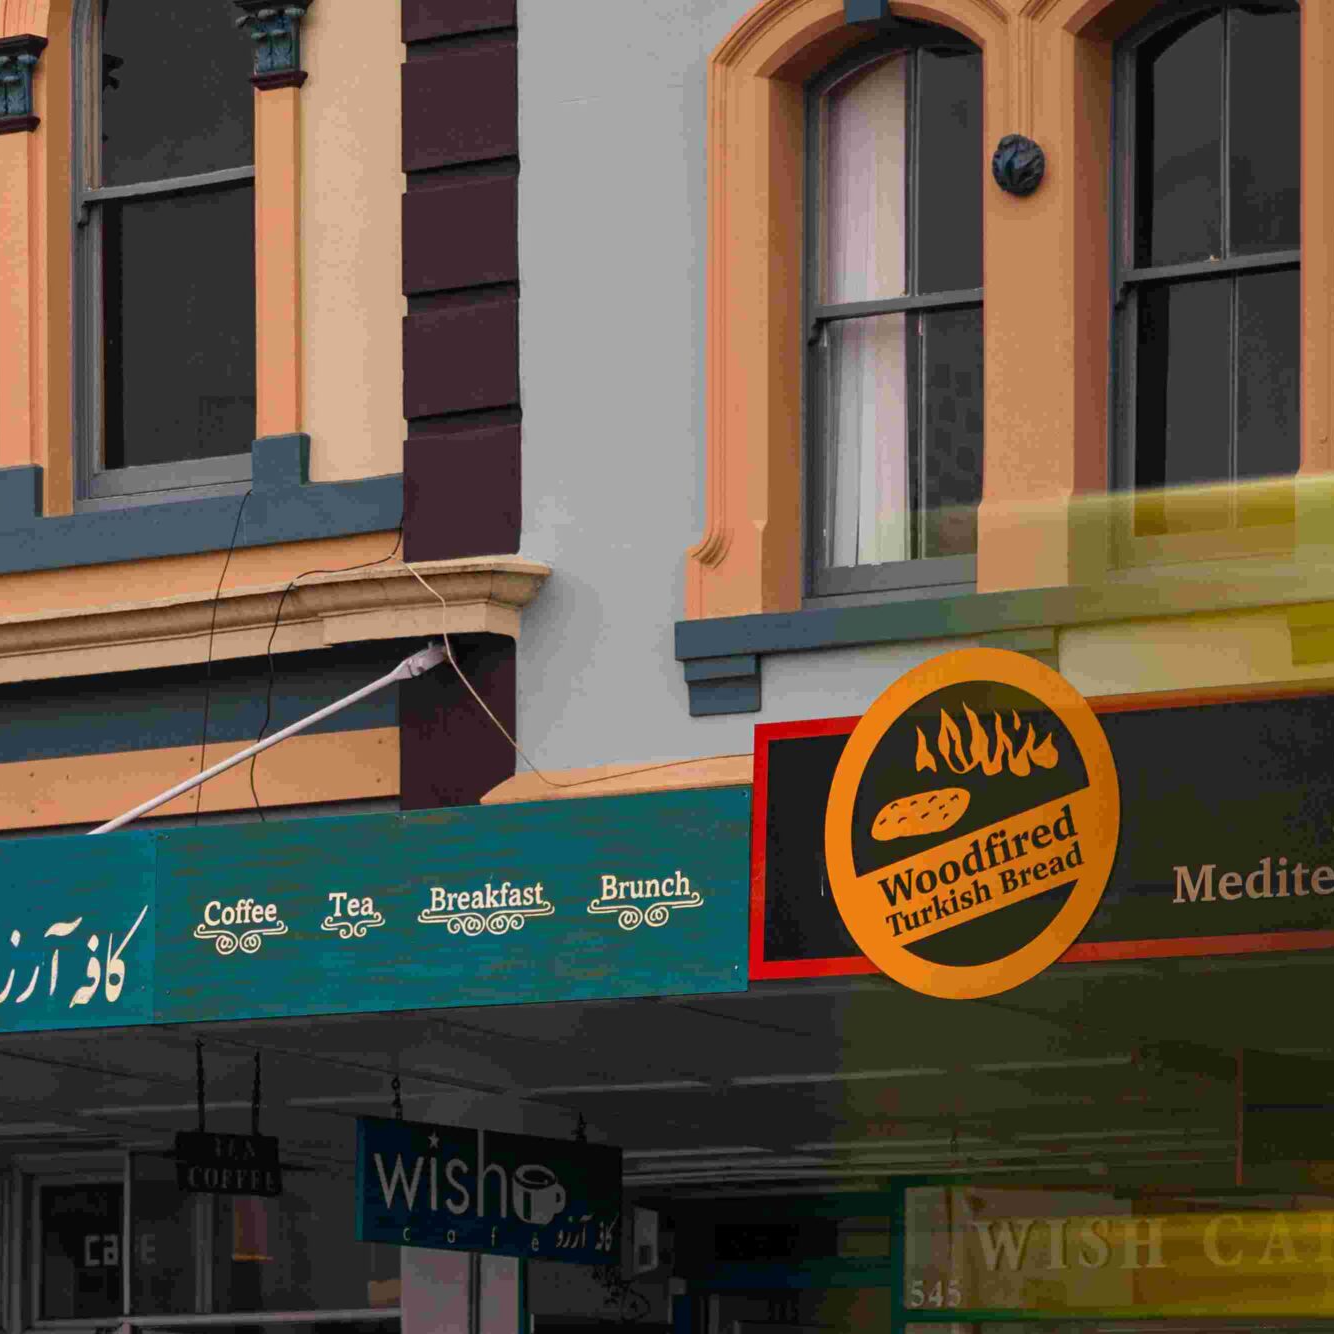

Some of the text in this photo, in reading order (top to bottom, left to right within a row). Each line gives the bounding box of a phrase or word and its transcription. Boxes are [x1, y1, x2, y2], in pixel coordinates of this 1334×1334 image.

[877, 804, 1079, 907] Woodfired
[429, 882, 545, 912] Breakfast
[600, 870, 691, 901] Brunch
[885, 842, 1085, 937] Turkish Bread
[203, 897, 278, 927] Coffee
[328, 891, 375, 919] Tea
[373, 1128, 508, 1218] wish
[975, 1214, 1167, 1272] WISH
[909, 1279, 963, 1307] 545
